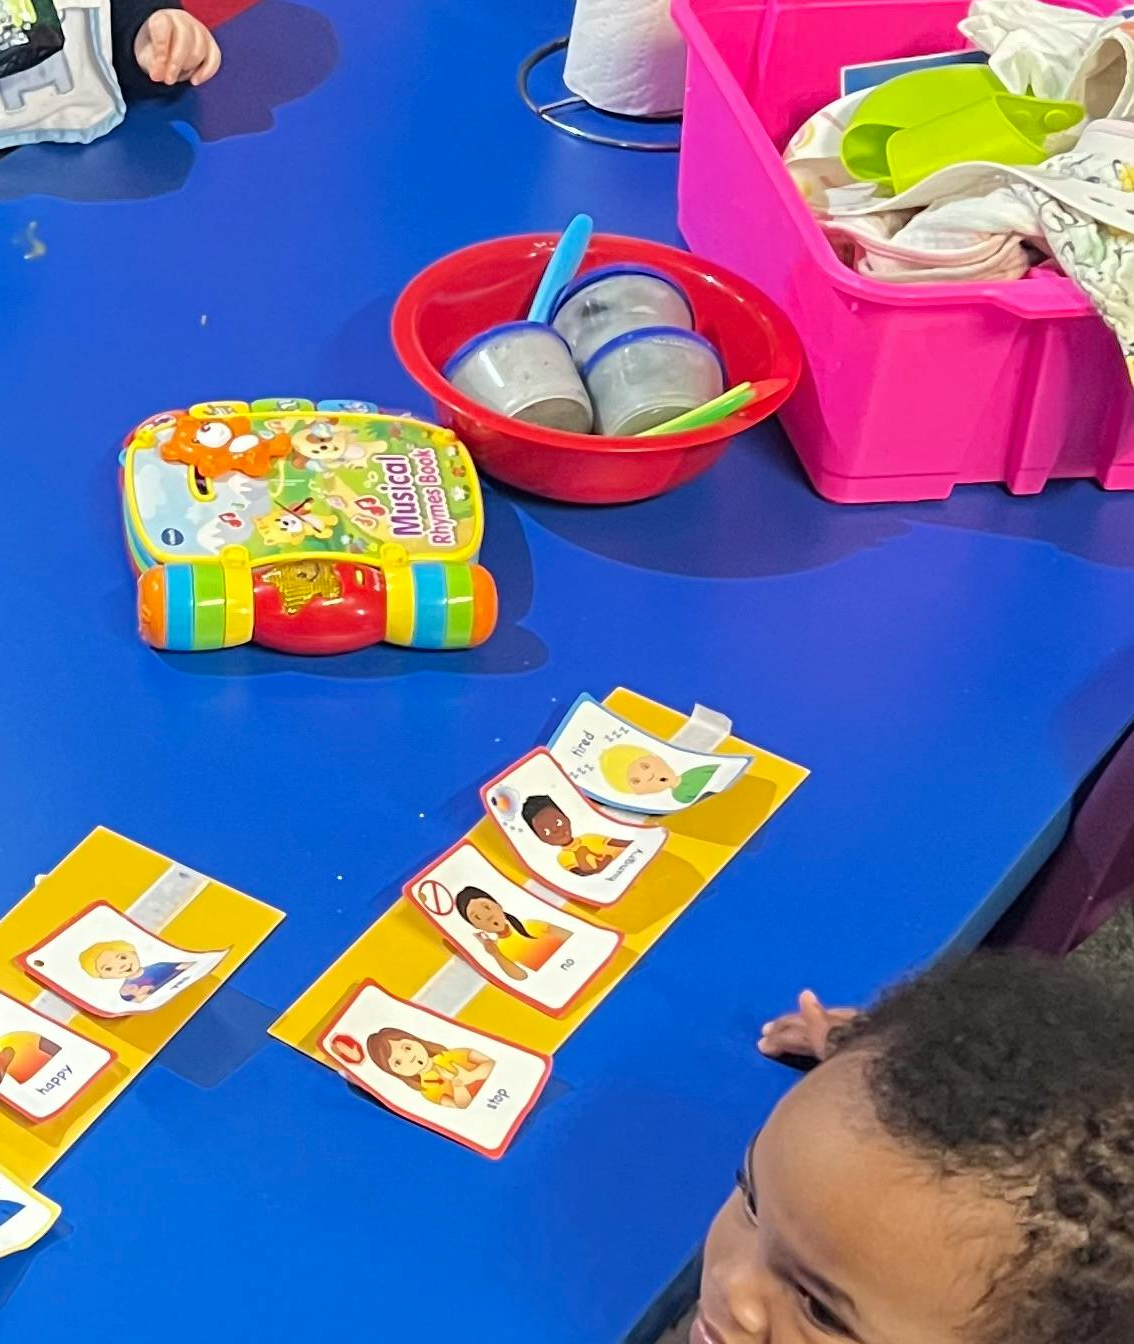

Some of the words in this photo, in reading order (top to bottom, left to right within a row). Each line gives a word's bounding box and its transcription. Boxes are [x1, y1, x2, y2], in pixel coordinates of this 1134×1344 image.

[414, 449, 439, 484] Book
[374, 456, 423, 536] Musical
[425, 488, 454, 545] Rhymes
[570, 729, 595, 758] tired
[604, 848, 644, 882] hungry
[560, 958, 575, 972] no
[35, 1063, 73, 1096] happy
[486, 1087, 511, 1111] stop
